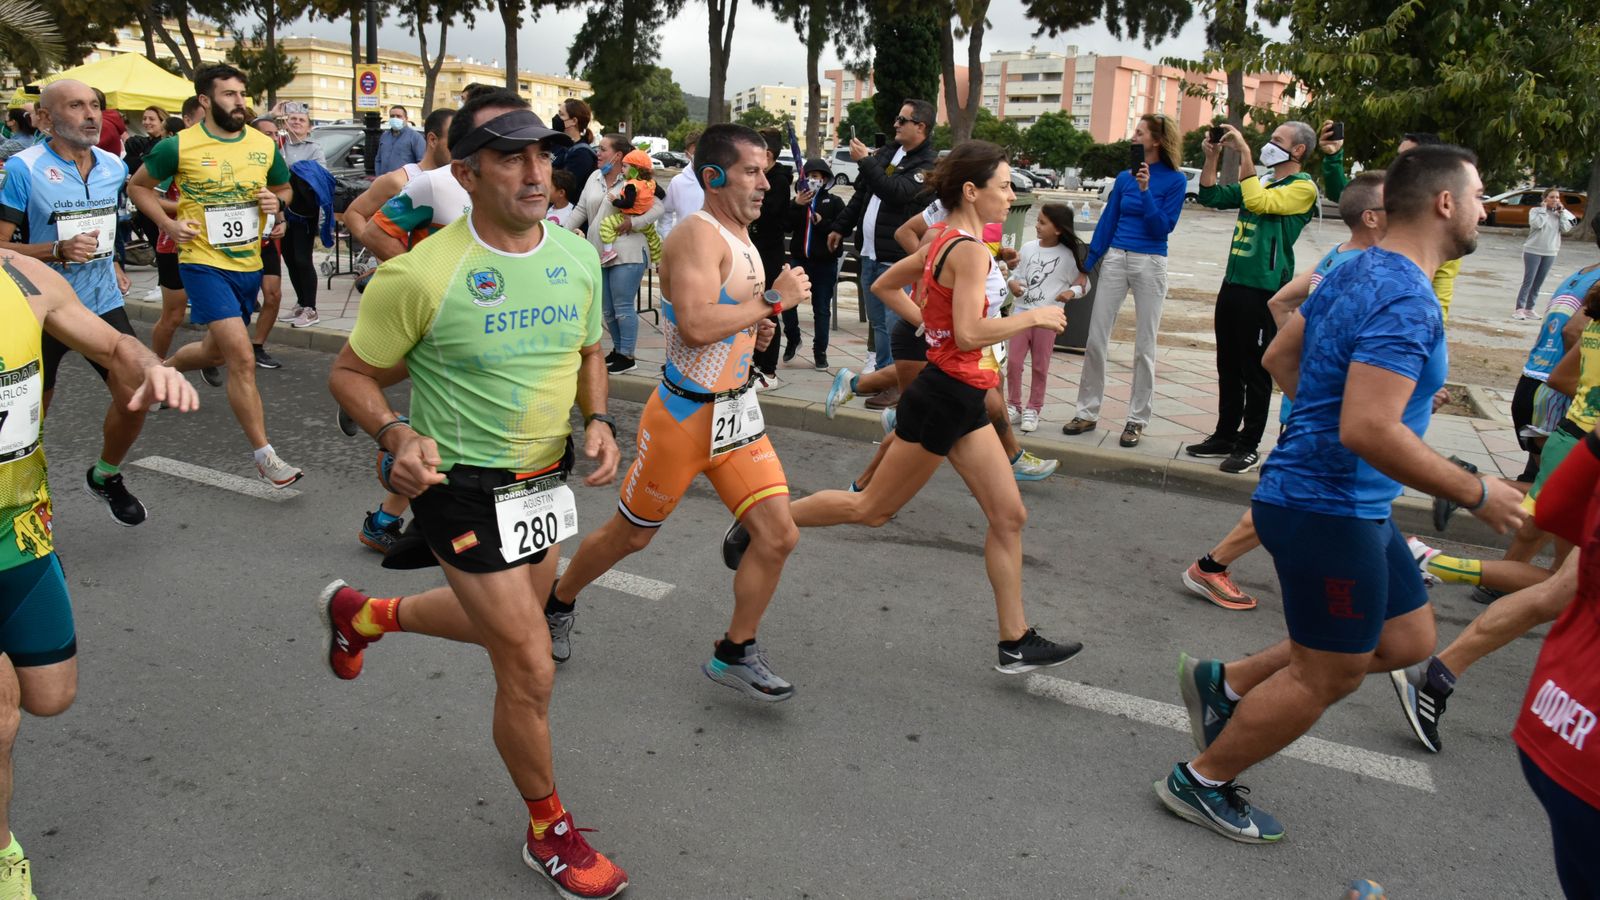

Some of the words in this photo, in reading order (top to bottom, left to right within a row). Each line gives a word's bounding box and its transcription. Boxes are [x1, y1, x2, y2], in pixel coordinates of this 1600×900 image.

[53, 200, 73, 208] club
[75, 199, 85, 208] de
[222, 220, 243, 238] 39
[484, 304, 579, 334] ESTEPONA
[737, 353, 750, 378] 5
[523, 492, 554, 510] AGUSTIN
[645, 486, 668, 500] DINGO
[514, 512, 558, 555] 280
[1530, 679, 1597, 751] DIDIER
